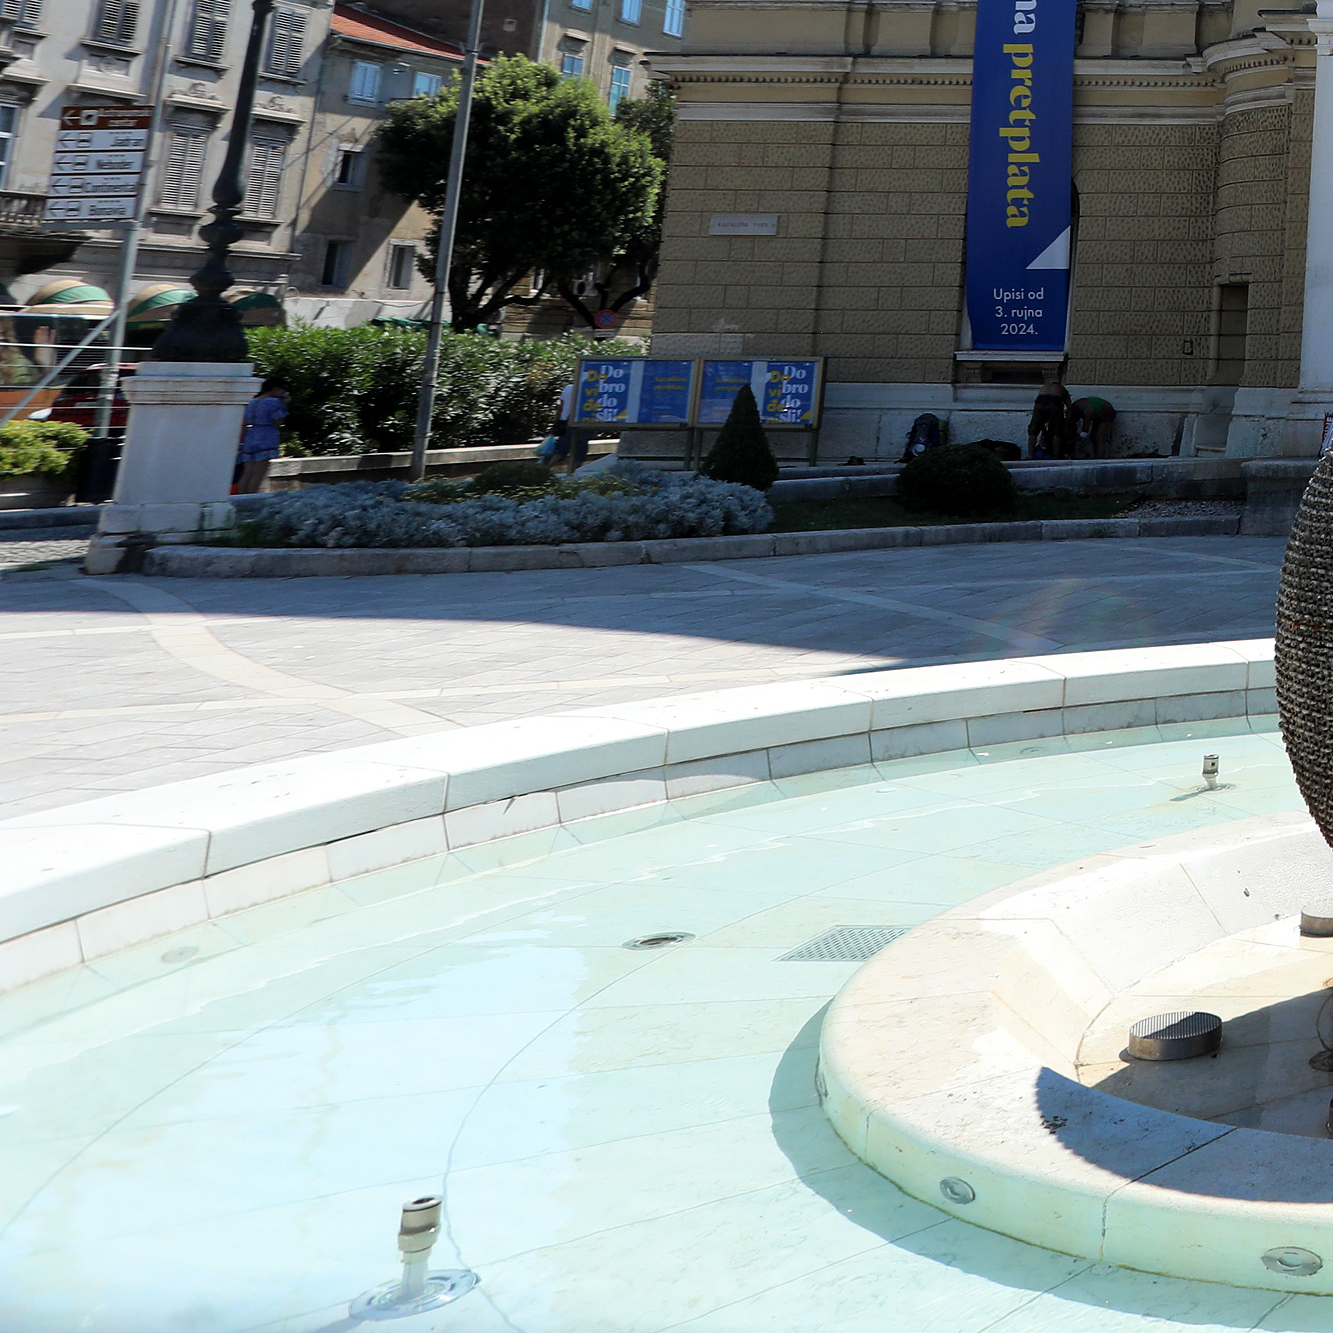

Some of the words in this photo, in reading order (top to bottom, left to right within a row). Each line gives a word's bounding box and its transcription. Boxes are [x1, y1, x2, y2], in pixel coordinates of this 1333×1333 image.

[999, 43, 1041, 228] pretplata
[993, 288, 1024, 303] Upisi
[1028, 288, 1044, 301] od
[995, 306, 1008, 318] 3.
[1011, 307, 1043, 321] rujna
[1000, 324, 1038, 335] 2024.
[599, 380, 626, 393] bro
[782, 381, 809, 394] bro
[597, 394, 618, 408] do
[780, 395, 801, 409] do
